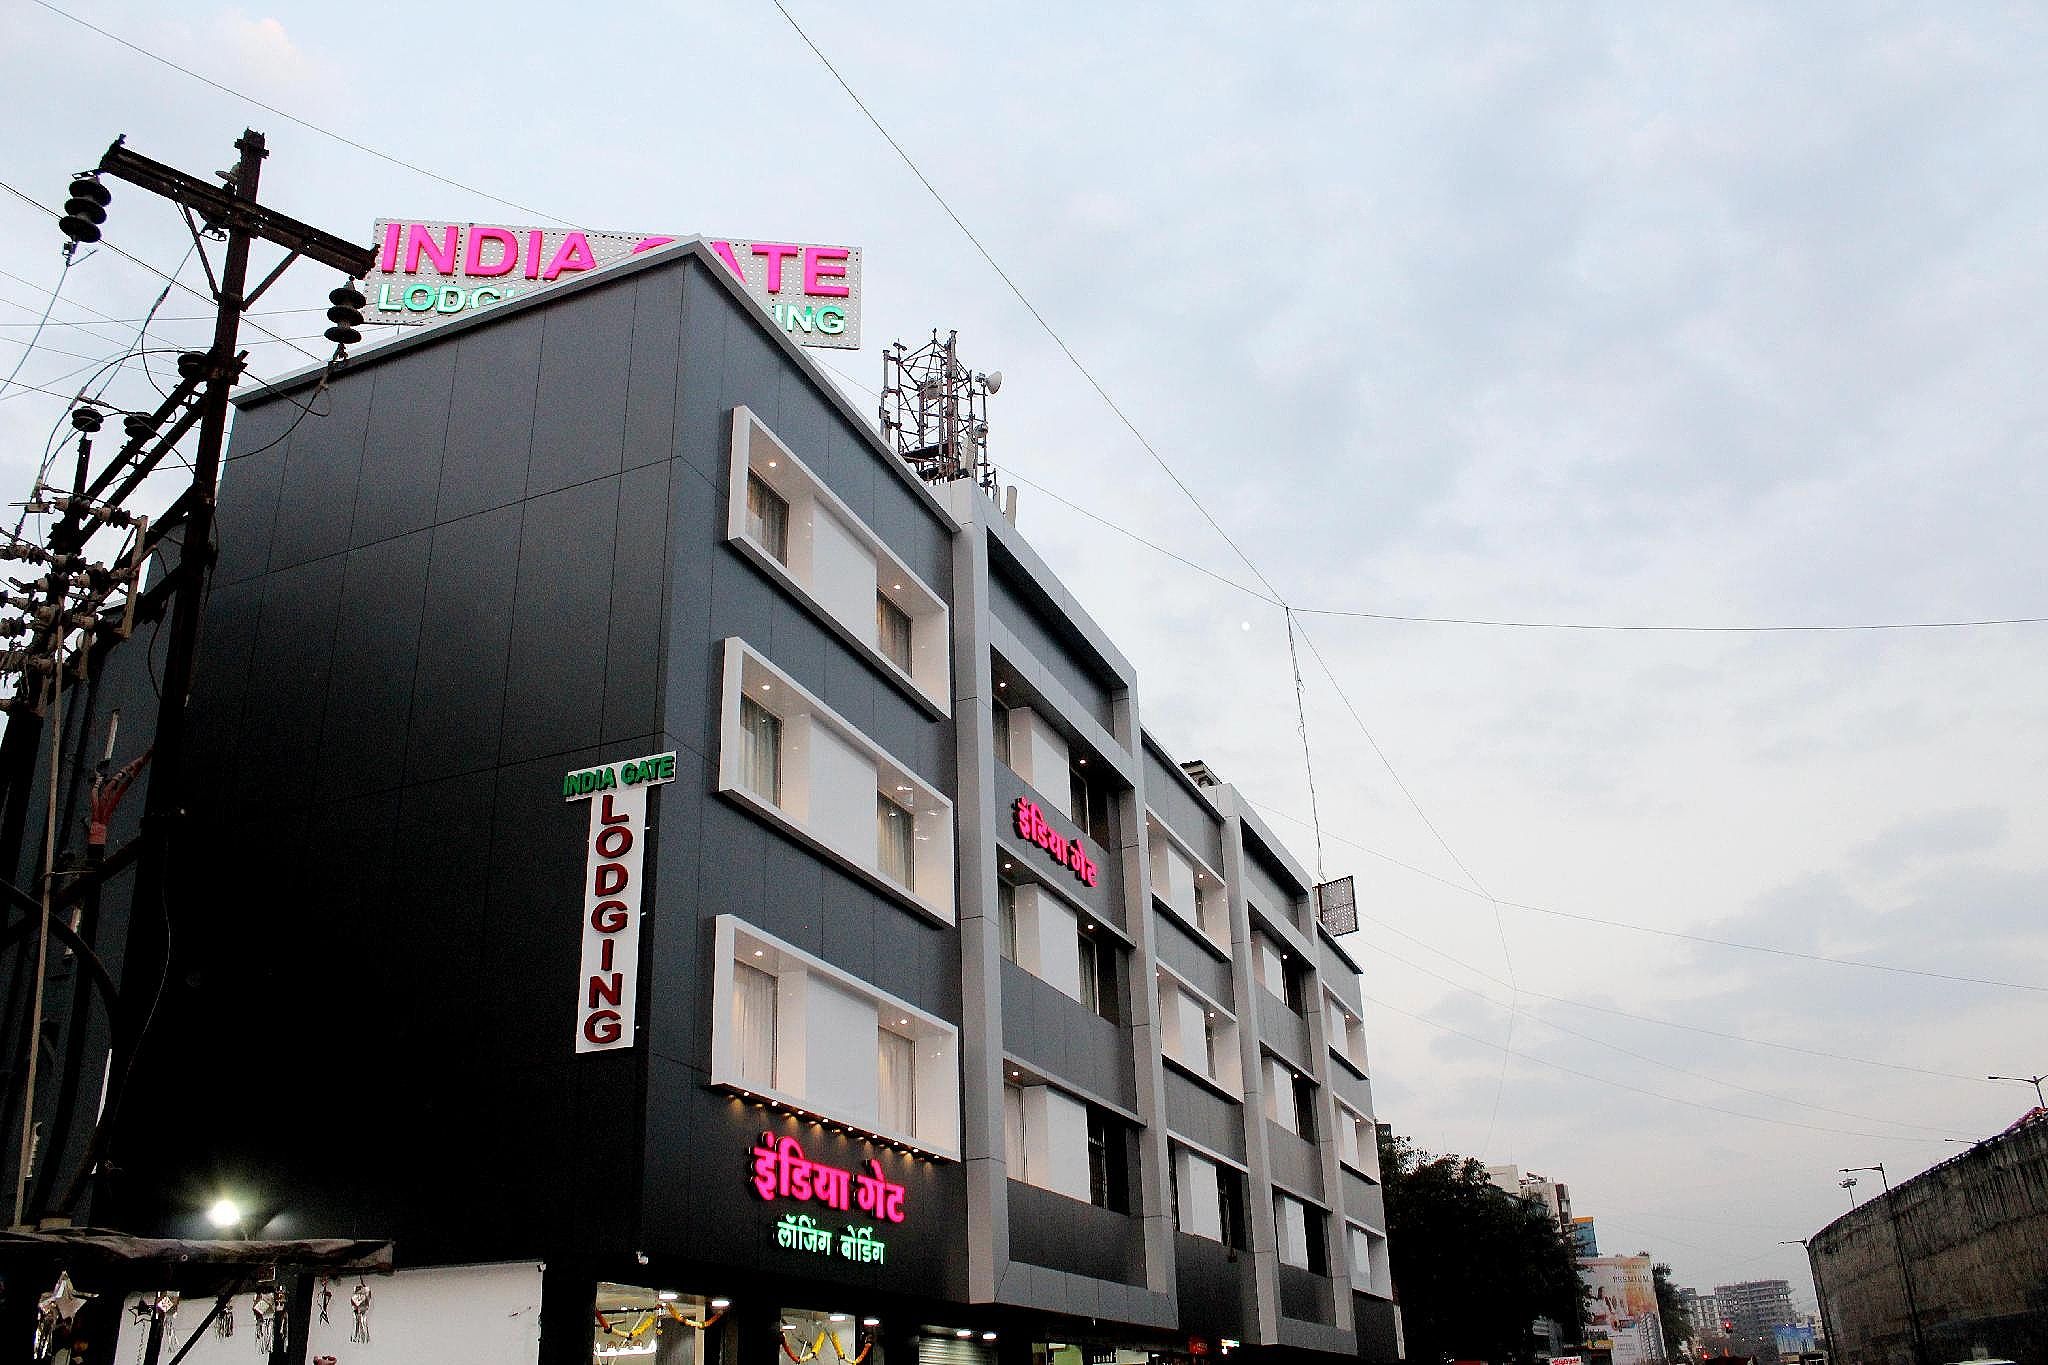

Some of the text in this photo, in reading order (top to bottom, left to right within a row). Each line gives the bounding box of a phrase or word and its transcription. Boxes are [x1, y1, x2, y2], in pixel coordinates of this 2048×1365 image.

[381, 223, 849, 298] INDIA TE
[562, 754, 675, 797] INDIA GATE
[1014, 795, 1098, 888] इंडिया गेट
[583, 794, 634, 1044] LODGING
[752, 1130, 907, 1224] इंडिया गेट
[776, 1213, 833, 1256] लॉजिंग
